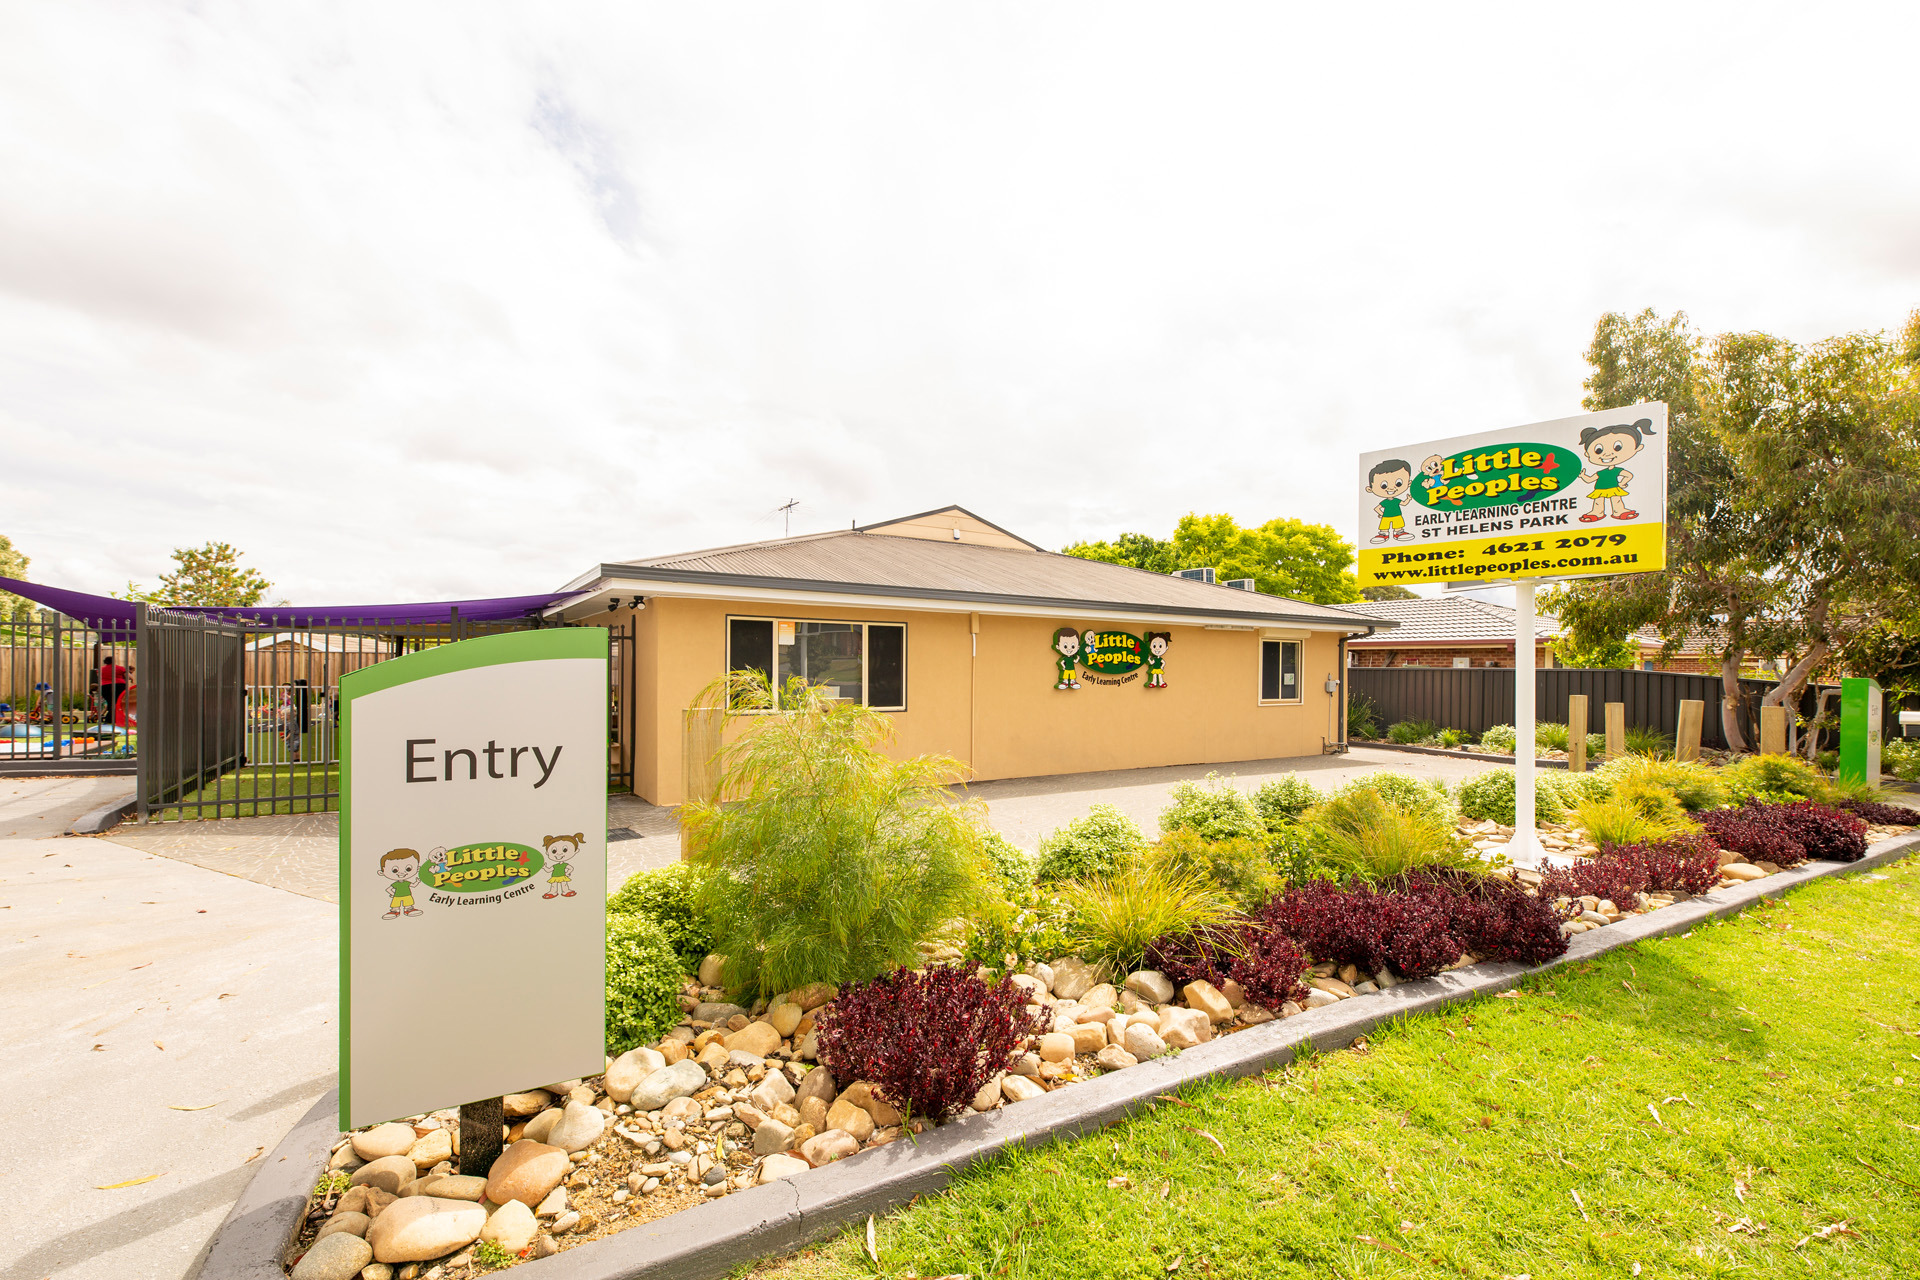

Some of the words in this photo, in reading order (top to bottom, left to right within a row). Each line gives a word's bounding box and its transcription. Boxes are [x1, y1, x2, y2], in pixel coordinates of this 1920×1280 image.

[1440, 447, 1542, 480] Little
[1426, 474, 1560, 506] Peoples
[1414, 511, 1453, 526] EARLY
[1455, 504, 1518, 521] LEARNING
[1523, 497, 1578, 515] CENTRE
[1421, 527, 1442, 538] ST
[1446, 520, 1514, 536] HELENS
[1520, 514, 1568, 528] PARK
[1381, 548, 1464, 564] Phone:
[1482, 540, 1544, 557] 4621
[1555, 534, 1626, 550] 2079
[1373, 552, 1638, 580] www.littlepeoples.com.au
[1094, 634, 1135, 648] Little
[1088, 651, 1140, 666] Peoples
[1082, 671, 1096, 685] Early
[1096, 678, 1120, 687] Learning
[1121, 672, 1138, 684] Centre
[406, 738, 563, 789] Entry
[445, 846, 520, 868] Little
[433, 864, 530, 888] Peoples
[429, 892, 456, 907] Early
[457, 893, 502, 906] Learning
[504, 882, 536, 900] Centre
